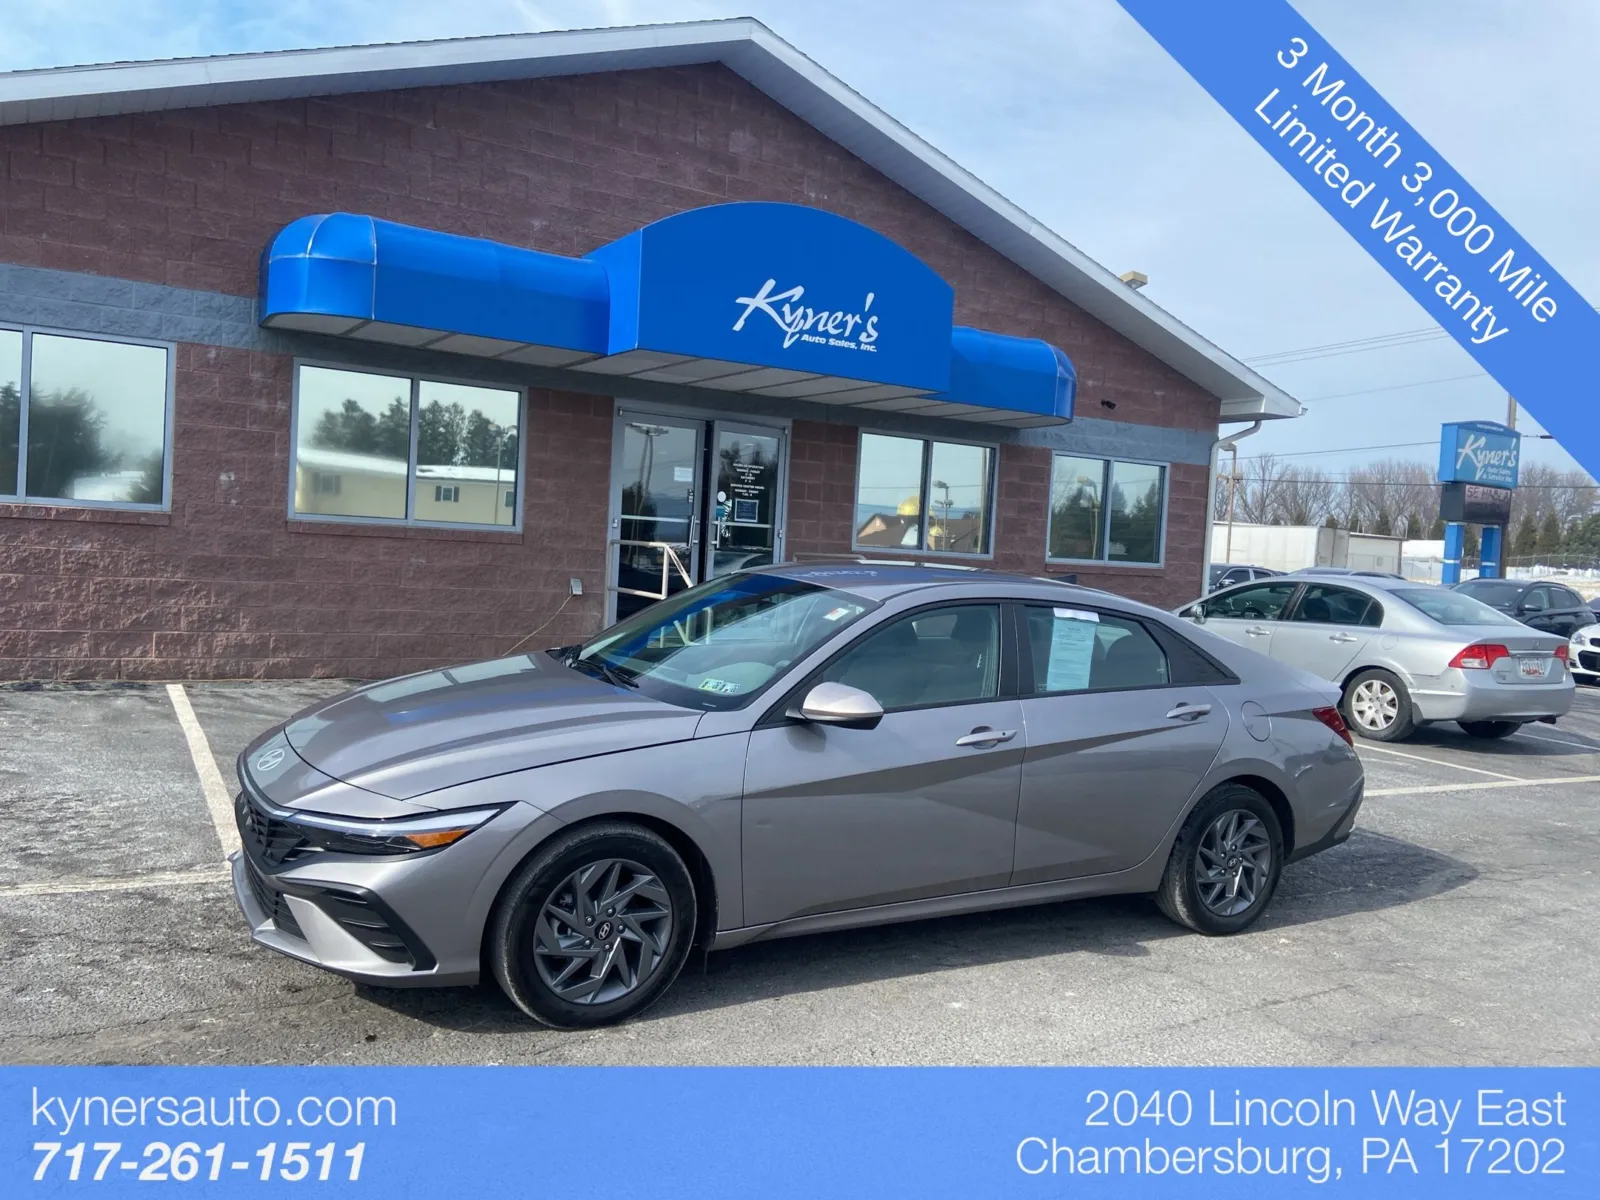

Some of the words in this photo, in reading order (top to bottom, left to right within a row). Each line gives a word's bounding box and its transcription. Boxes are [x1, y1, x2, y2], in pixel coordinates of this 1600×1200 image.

[732, 278, 879, 349] Kyner's
[801, 333, 827, 344] Auto
[828, 337, 858, 351] Sales,
[860, 343, 878, 352] Inc.
[1456, 434, 1517, 480] Kyner's
[1466, 486, 1479, 498] SE
